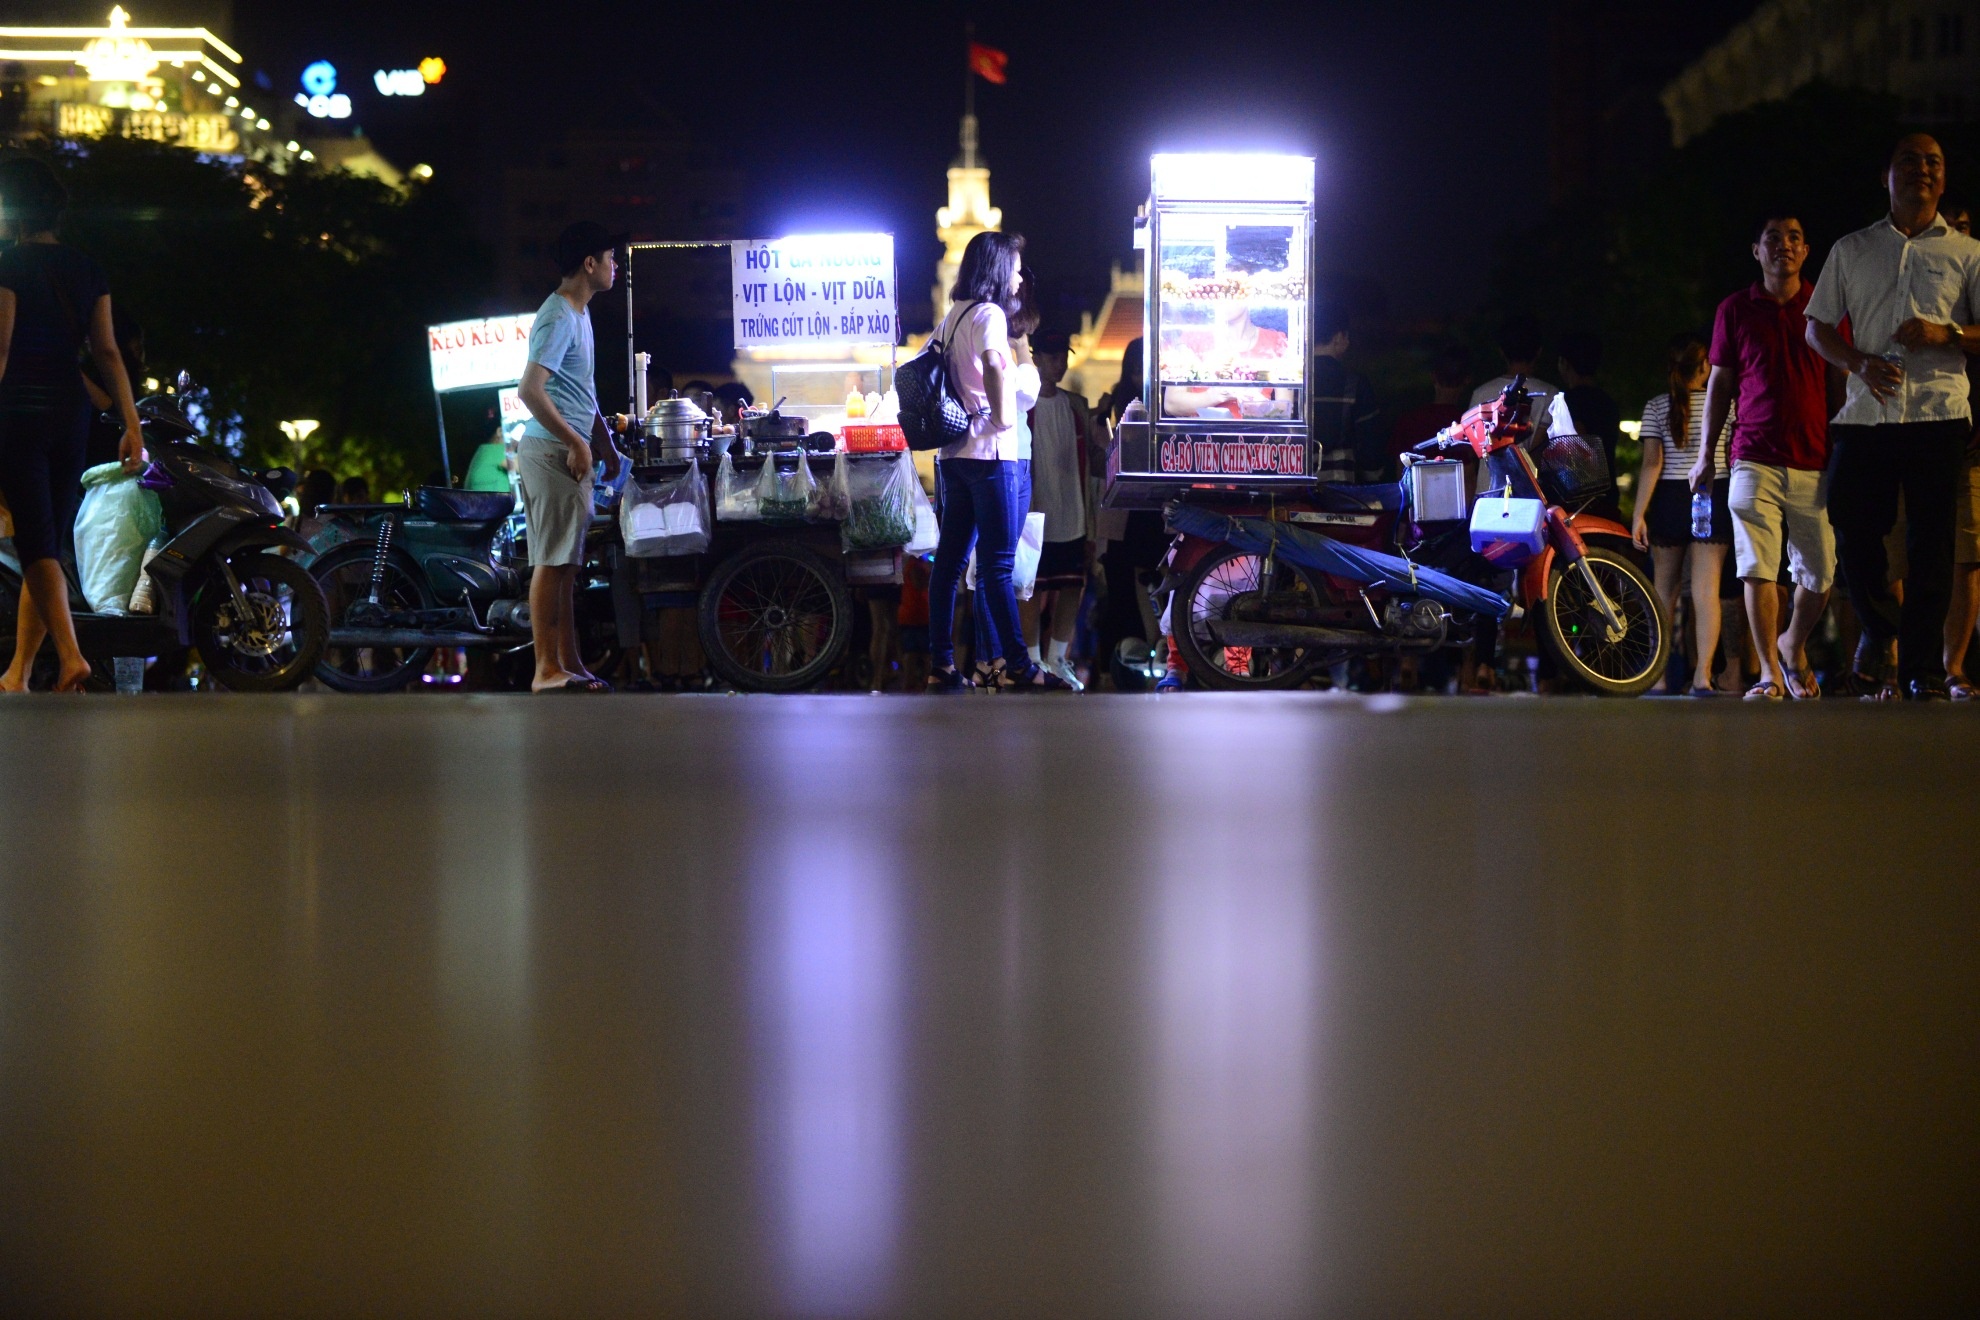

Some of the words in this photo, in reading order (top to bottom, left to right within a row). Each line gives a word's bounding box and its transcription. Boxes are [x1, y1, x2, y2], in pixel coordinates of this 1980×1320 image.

[746, 245, 781, 273] HỘT
[742, 283, 767, 307] VỊT
[774, 278, 806, 305] LỘN
[822, 281, 846, 305] VỊT
[741, 312, 779, 338] TRỨNG
[782, 312, 803, 336] CÚT
[808, 311, 830, 339] LỘN
[841, 306, 864, 335] BẮP
[867, 309, 890, 334] XÀO
[1194, 435, 1220, 473] VIÊN
[1277, 436, 1304, 474] XÍCH
